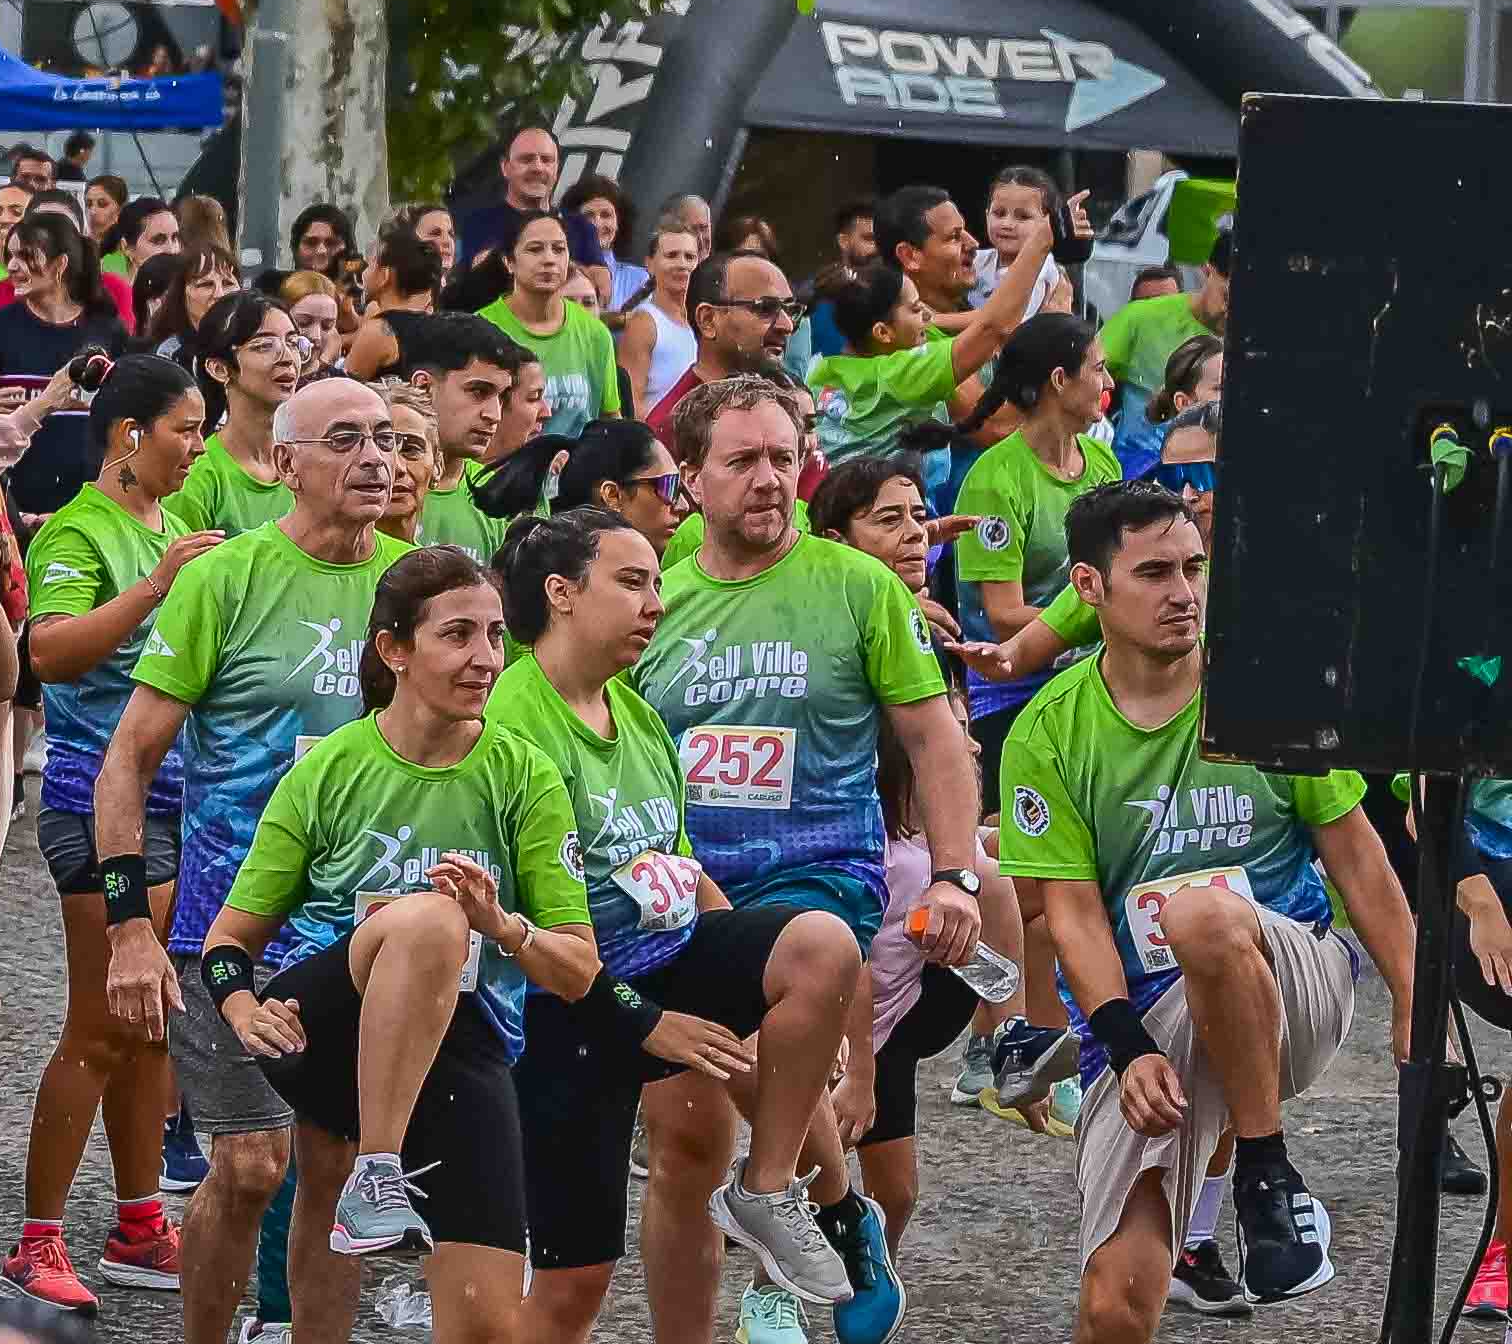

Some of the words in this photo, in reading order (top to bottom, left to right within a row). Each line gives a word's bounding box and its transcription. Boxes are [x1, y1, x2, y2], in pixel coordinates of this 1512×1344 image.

[821, 20, 1118, 83] POWER
[751, 640, 808, 676] Ville
[683, 674, 808, 707] corre
[686, 733, 785, 788] 252
[1189, 784, 1254, 827] Ville
[1152, 822, 1253, 857] orre
